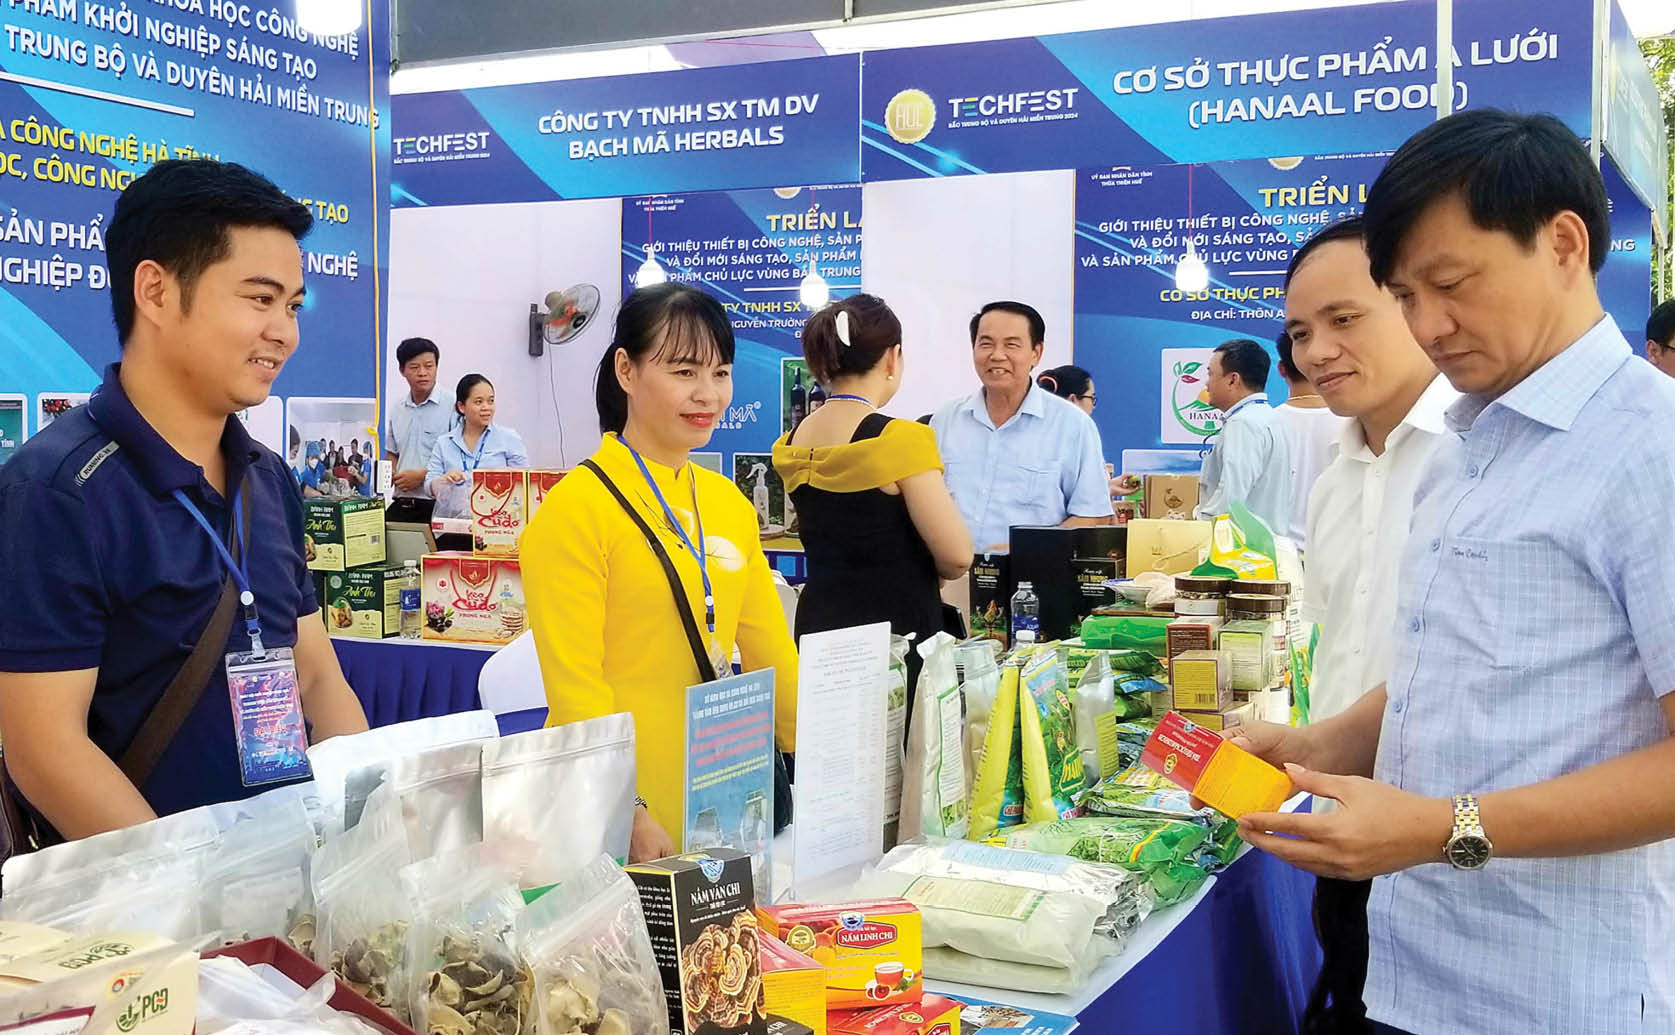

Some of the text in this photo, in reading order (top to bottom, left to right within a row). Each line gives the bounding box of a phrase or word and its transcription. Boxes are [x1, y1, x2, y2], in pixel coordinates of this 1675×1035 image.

[210, 0, 251, 28] HỌC
[256, 8, 308, 42] CÔNG
[84, 1, 138, 37] KHỞI
[145, 16, 221, 58] NGHIỆP
[226, 36, 278, 71] SÁNG
[282, 52, 317, 81] TẠO
[1113, 65, 1157, 94] CƠ
[1164, 57, 1210, 90] SỞ
[1217, 54, 1309, 86] THỰC
[1318, 36, 1427, 79] PHẨM
[1471, 27, 1558, 66] LƯỚI
[4, 24, 380, 129] TRUNG BỘ VÀ DUYÊN HẢI MIỀN TRUNG
[538, 94, 819, 134] CÔNG TY TNHH SX TM DV
[949, 88, 1079, 118] TECHFEST
[1189, 91, 1346, 129] (HANAAL
[11, 115, 75, 149] CÔNG
[79, 131, 138, 163] NGHỆ
[142, 139, 170, 163] HÀ
[393, 131, 490, 155] TECHFEST
[569, 126, 784, 161] BẠCH MÃ HERBALS
[34, 154, 96, 187] CÔNG
[1259, 176, 1349, 208] TRIỂN
[316, 201, 349, 226] TẠO
[766, 203, 836, 232] TRIỂN
[1099, 218, 1127, 232] GIỚI
[1132, 216, 1173, 232] THIỆU
[1177, 213, 1217, 229] THIẾT
[1221, 215, 1235, 230] BỊ
[1240, 213, 1283, 227] CÔNG
[642, 240, 665, 253] GIỚI
[668, 239, 700, 253] THIỆU
[704, 236, 735, 250] THIẾT
[738, 238, 749, 251] BỊ
[752, 235, 787, 249] CÔNG
[789, 234, 825, 248] NGHỆ,
[827, 232, 847, 246] SẢN
[1130, 235, 1147, 249] VÀ
[1152, 232, 1177, 248] ĐỔI
[1213, 231, 1253, 245] SÁNG
[1258, 232, 1291, 246] TẠO,
[308, 251, 358, 280] NGHỆ
[667, 255, 681, 267] VÀ
[684, 253, 704, 267] ĐỔI
[707, 251, 728, 266] MỚI
[731, 251, 762, 265] SÁNG
[765, 253, 792, 267] TẠO,
[822, 246, 857, 262] PHẨM
[1081, 253, 1099, 267] VÀ
[1103, 250, 1131, 266] SẢN
[1134, 249, 1173, 265] PHẨM
[1213, 250, 1242, 265] LỰC
[1246, 248, 1288, 262] VÙNG
[670, 270, 702, 283] PHẨM
[705, 267, 729, 281] CHỦ
[732, 269, 753, 282] LỰC
[756, 268, 790, 280] VÙNG
[821, 266, 860, 277] TRUNG
[744, 302, 781, 313] TNHH
[784, 302, 801, 313] SX
[1215, 286, 1259, 302] THỰC
[1191, 310, 1211, 320] ĐỊA
[1214, 308, 1237, 320] CHỈ:
[1239, 309, 1274, 319] THÔN
[726, 882, 741, 897] CHI
[860, 933, 879, 942] LINH
[878, 931, 893, 940] CHI
